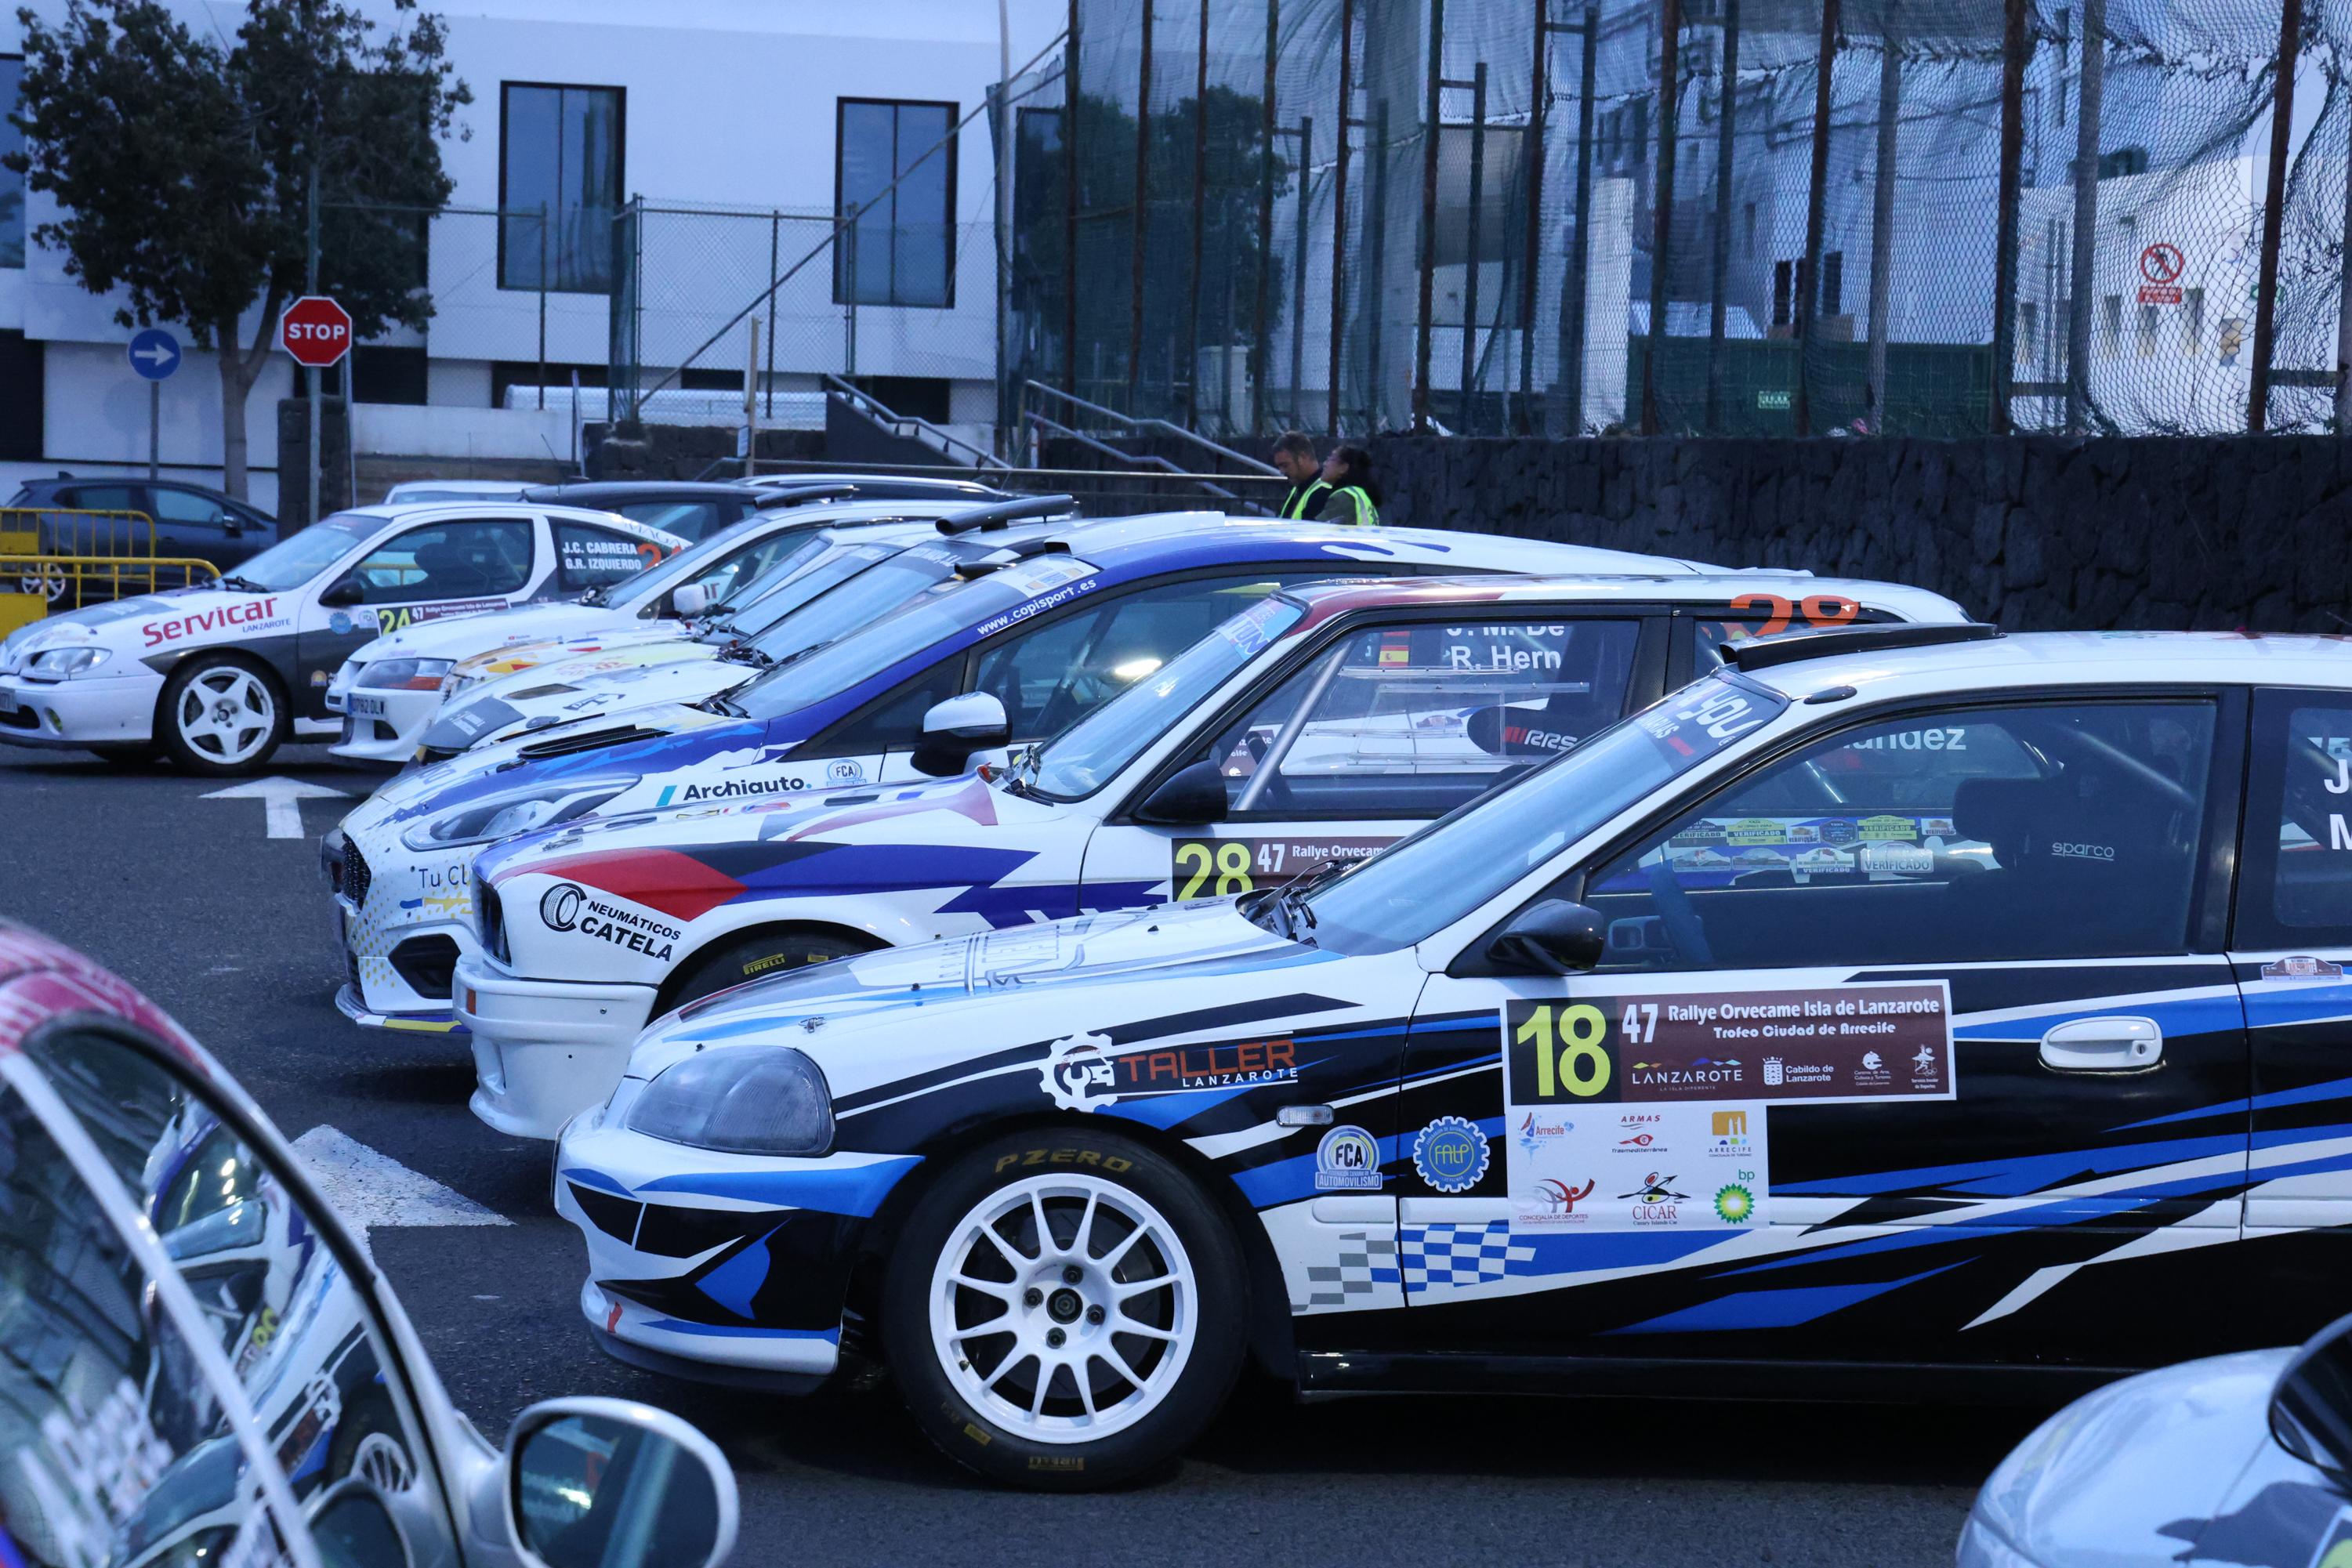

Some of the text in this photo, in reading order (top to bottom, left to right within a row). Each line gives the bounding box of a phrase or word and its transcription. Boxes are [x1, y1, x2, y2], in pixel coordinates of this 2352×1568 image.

[288, 323, 345, 339] STOP
[563, 542, 638, 555] J.C. CABRERA
[565, 559, 642, 570] G.R. IZQUIERDO
[977, 578, 1097, 635] www.copisport.es
[143, 597, 277, 648] Servicar
[242, 617, 291, 633] LANZAROTE
[379, 608, 411, 636] 24
[412, 607, 424, 621] 47
[1451, 646, 1562, 671] R. Hern
[835, 765, 854, 777] FCA
[1292, 845, 1328, 860] Rallye
[2051, 842, 2115, 858] sparco
[1176, 842, 1285, 901] 28 47
[1865, 860, 1930, 871] VERIFICADO
[419, 868, 440, 889] Tu
[588, 900, 681, 940] NEUMÁTICOS
[581, 917, 672, 961] CATELA
[1669, 998, 1940, 1025] Rallye Orvecame Isla de Lanzarote
[1713, 1021, 1897, 1039] Trofeo Ciudad de Arrecife
[1517, 1004, 1658, 1097] 18 47
[1118, 1039, 1296, 1082] TALLER
[1632, 1069, 1743, 1085] LANZAROTE
[1785, 1064, 1835, 1074] Cabildo de
[1183, 1068, 1298, 1088] LANZAROTE
[1786, 1074, 1831, 1082] Lanzarote
[1621, 1114, 1661, 1123] ARMAS
[1536, 1125, 1564, 1135] Arrecife
[1335, 1143, 1364, 1168] FCA
[1319, 1175, 1379, 1186] AUTOMOVILISMO
[1738, 1168, 1755, 1182] bp
[1633, 1205, 1677, 1220] CICAR
